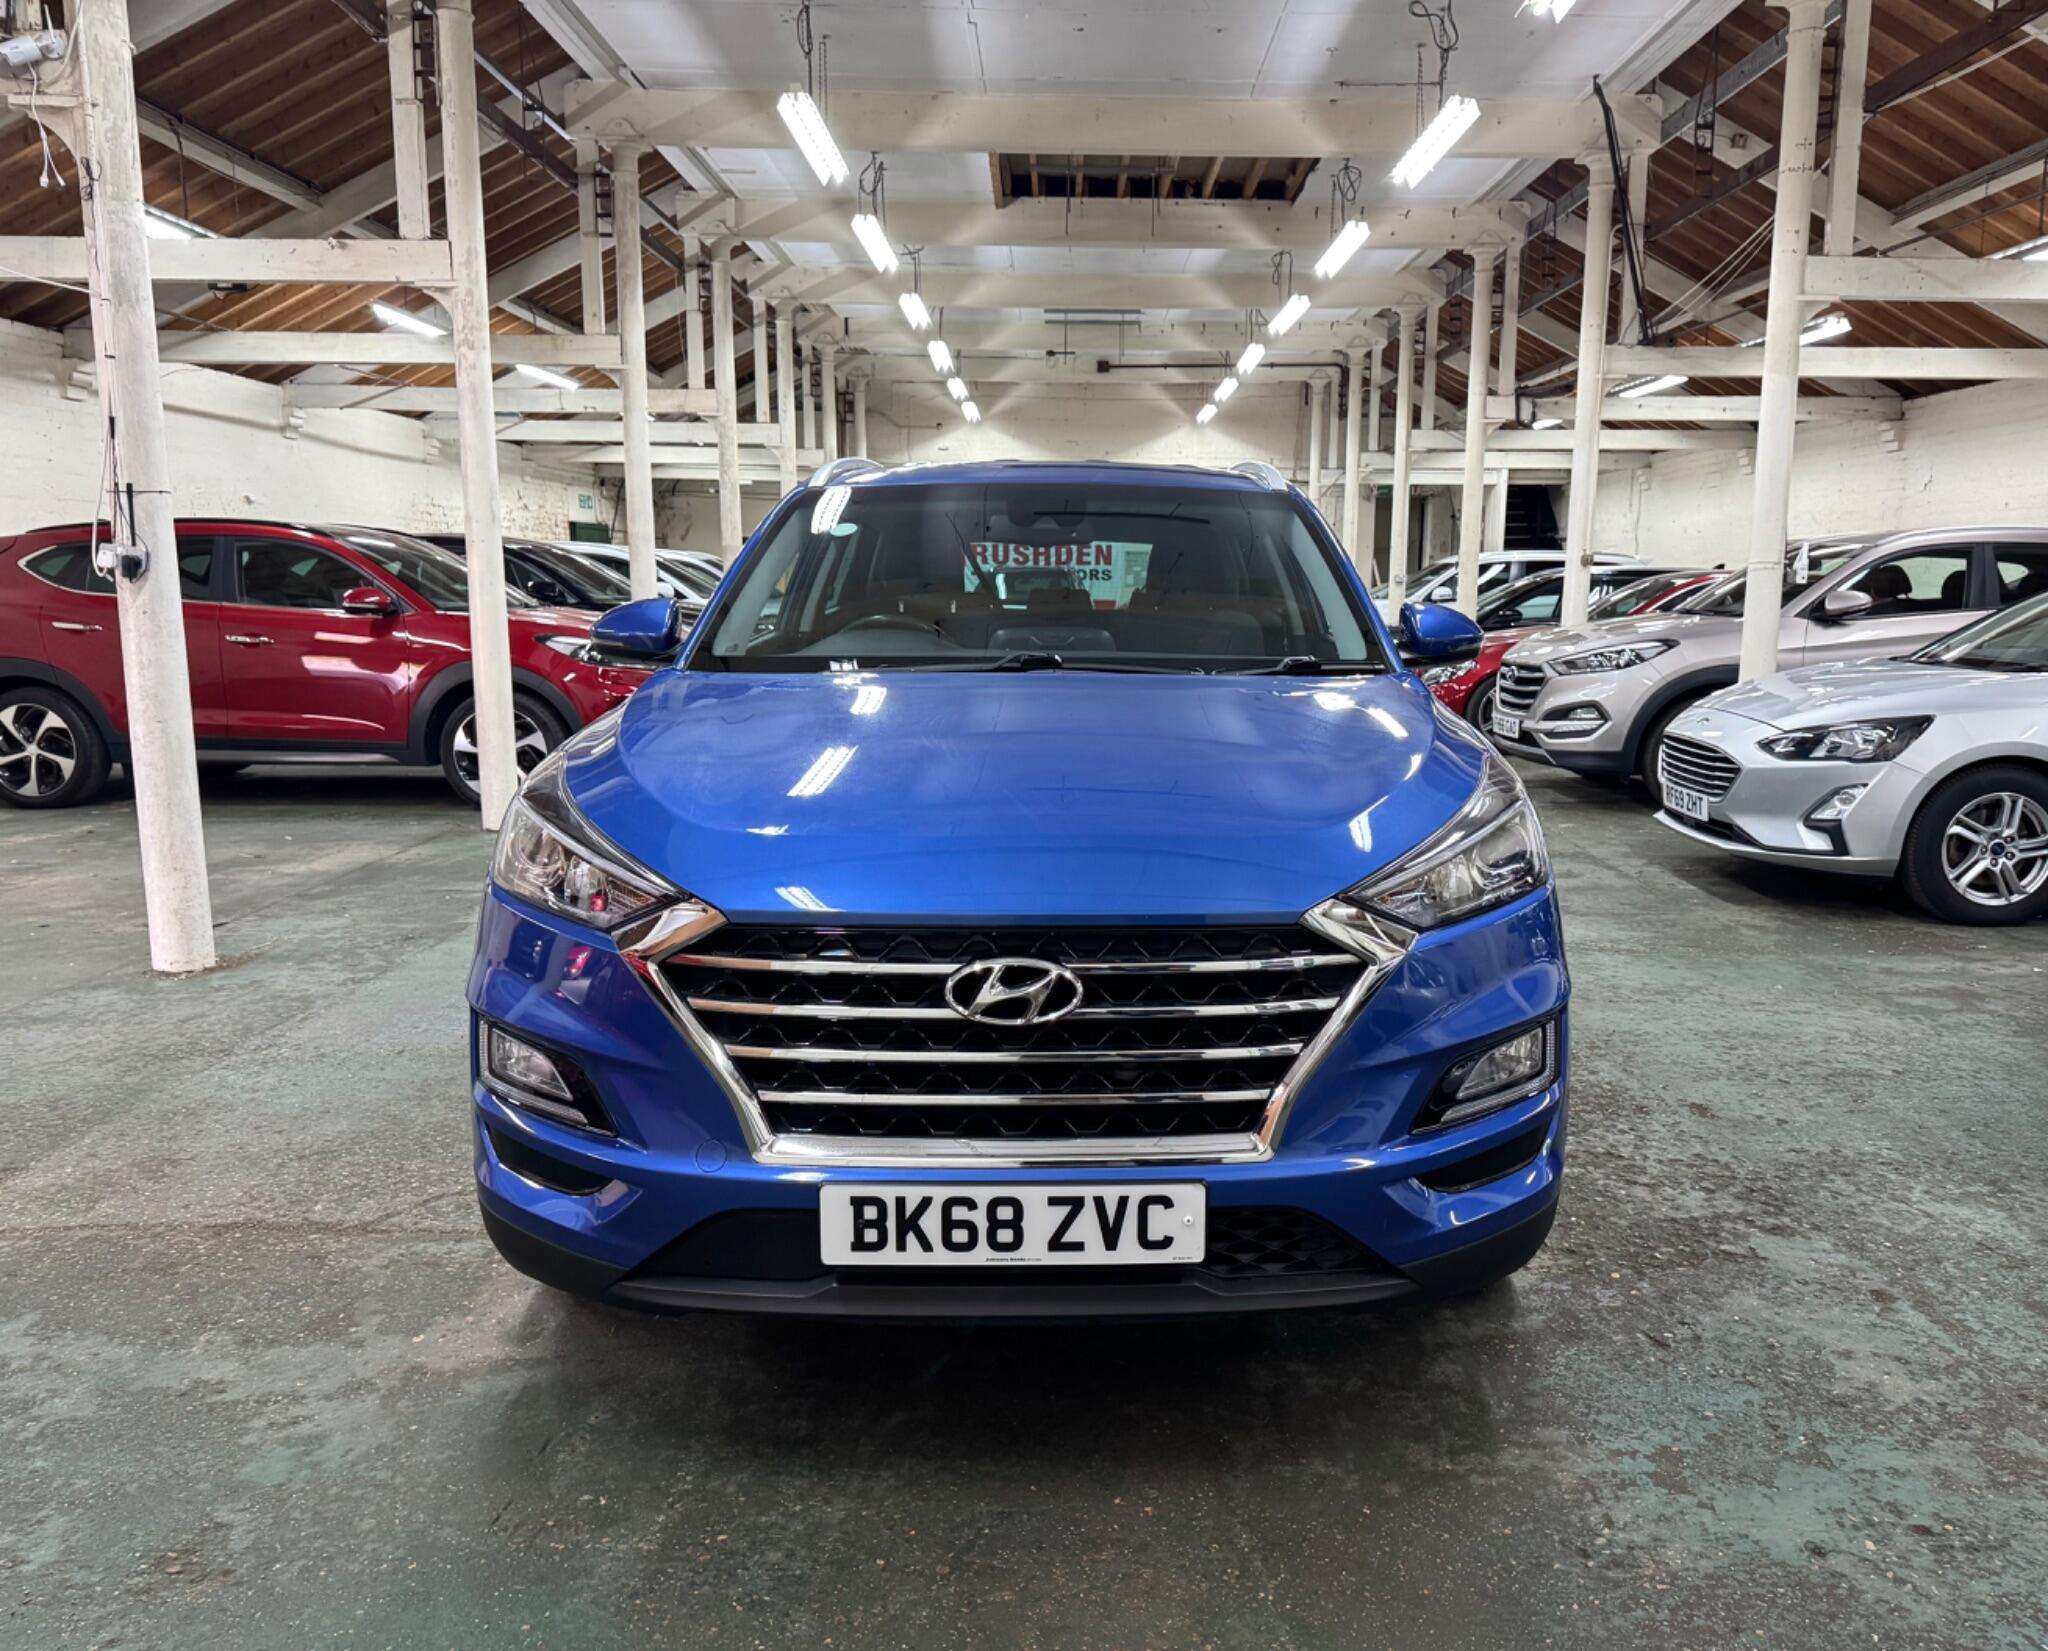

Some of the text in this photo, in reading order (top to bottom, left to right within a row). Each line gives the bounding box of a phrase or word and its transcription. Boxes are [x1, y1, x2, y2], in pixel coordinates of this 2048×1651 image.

[968, 543, 1112, 566] RUSHDEN
[1686, 792, 1704, 816] ZHT
[849, 1194, 1175, 1253] BK68 ZVC
